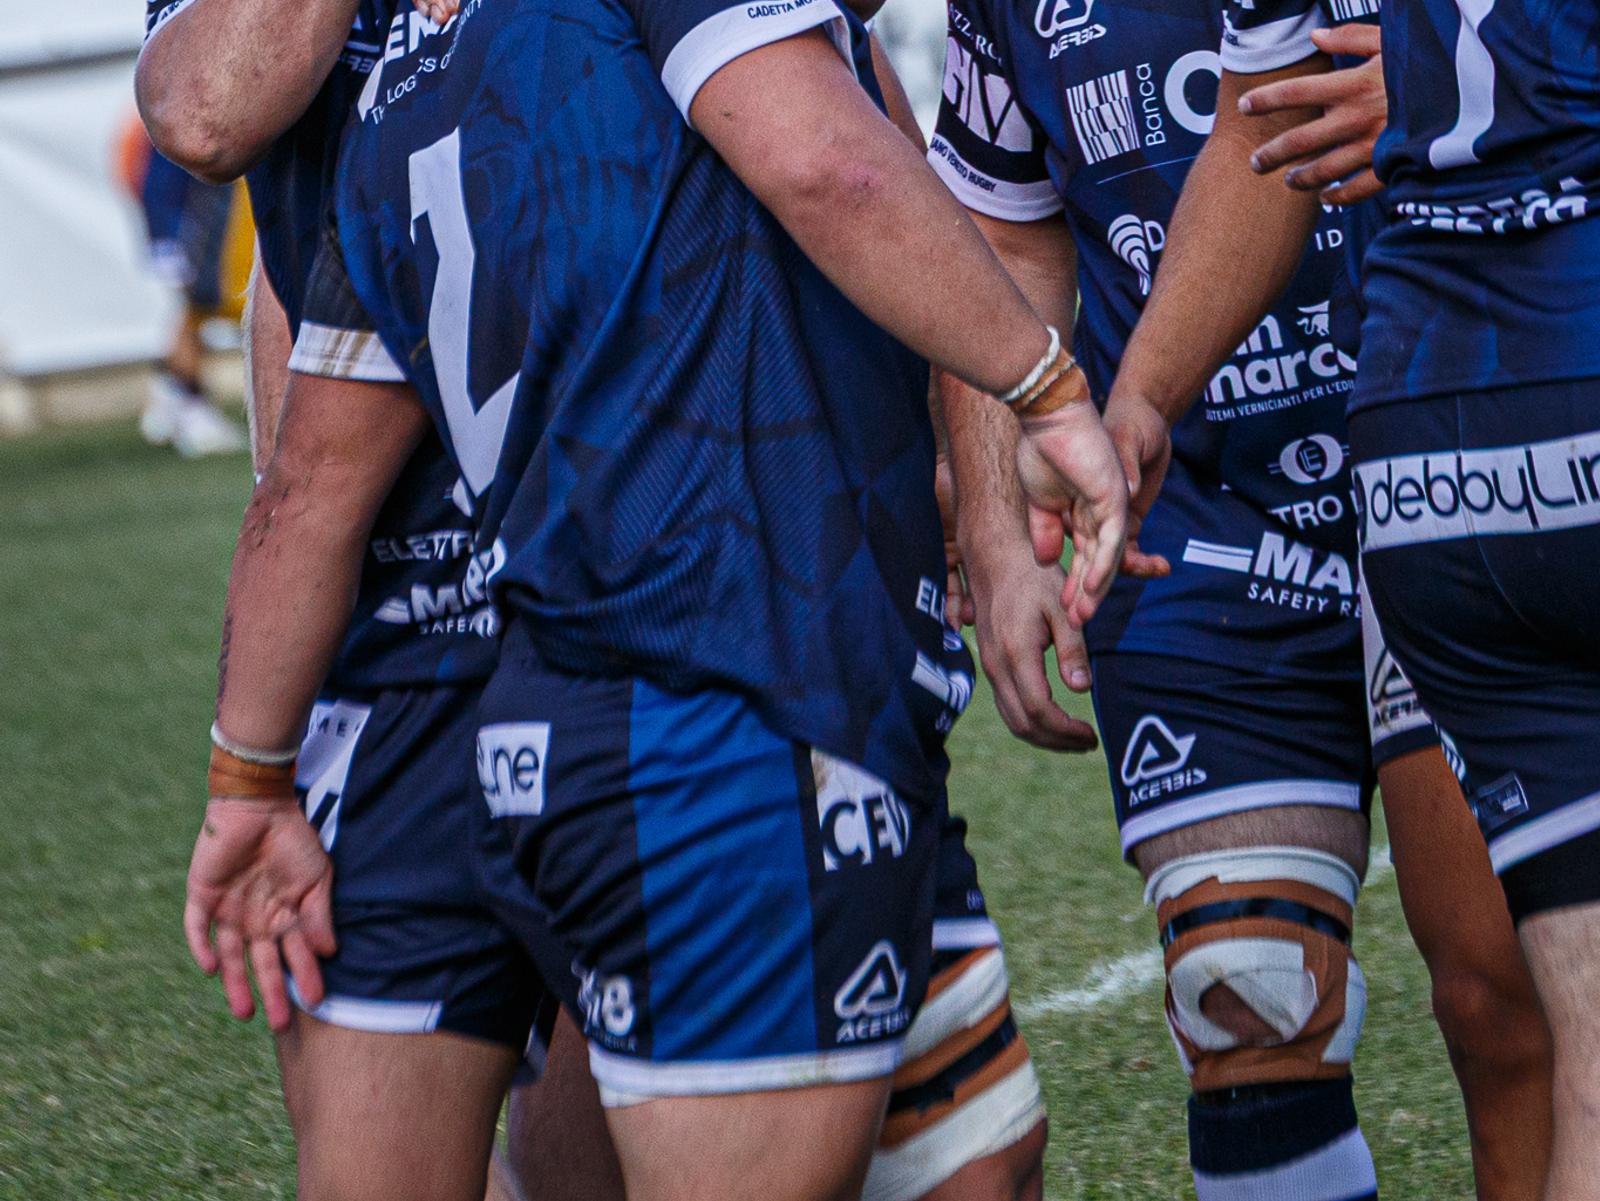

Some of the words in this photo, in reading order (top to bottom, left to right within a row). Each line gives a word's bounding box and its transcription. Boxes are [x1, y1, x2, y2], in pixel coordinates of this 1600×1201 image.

[747, 1, 795, 19] CADETTA
[1136, 63, 1167, 147] Banca
[967, 171, 997, 193] RUGBY
[1237, 394, 1302, 417] VERNICIANTI
[1302, 388, 1324, 402] PER
[1248, 582, 1329, 613] SAFETY
[1129, 767, 1207, 807] ACERBIS
